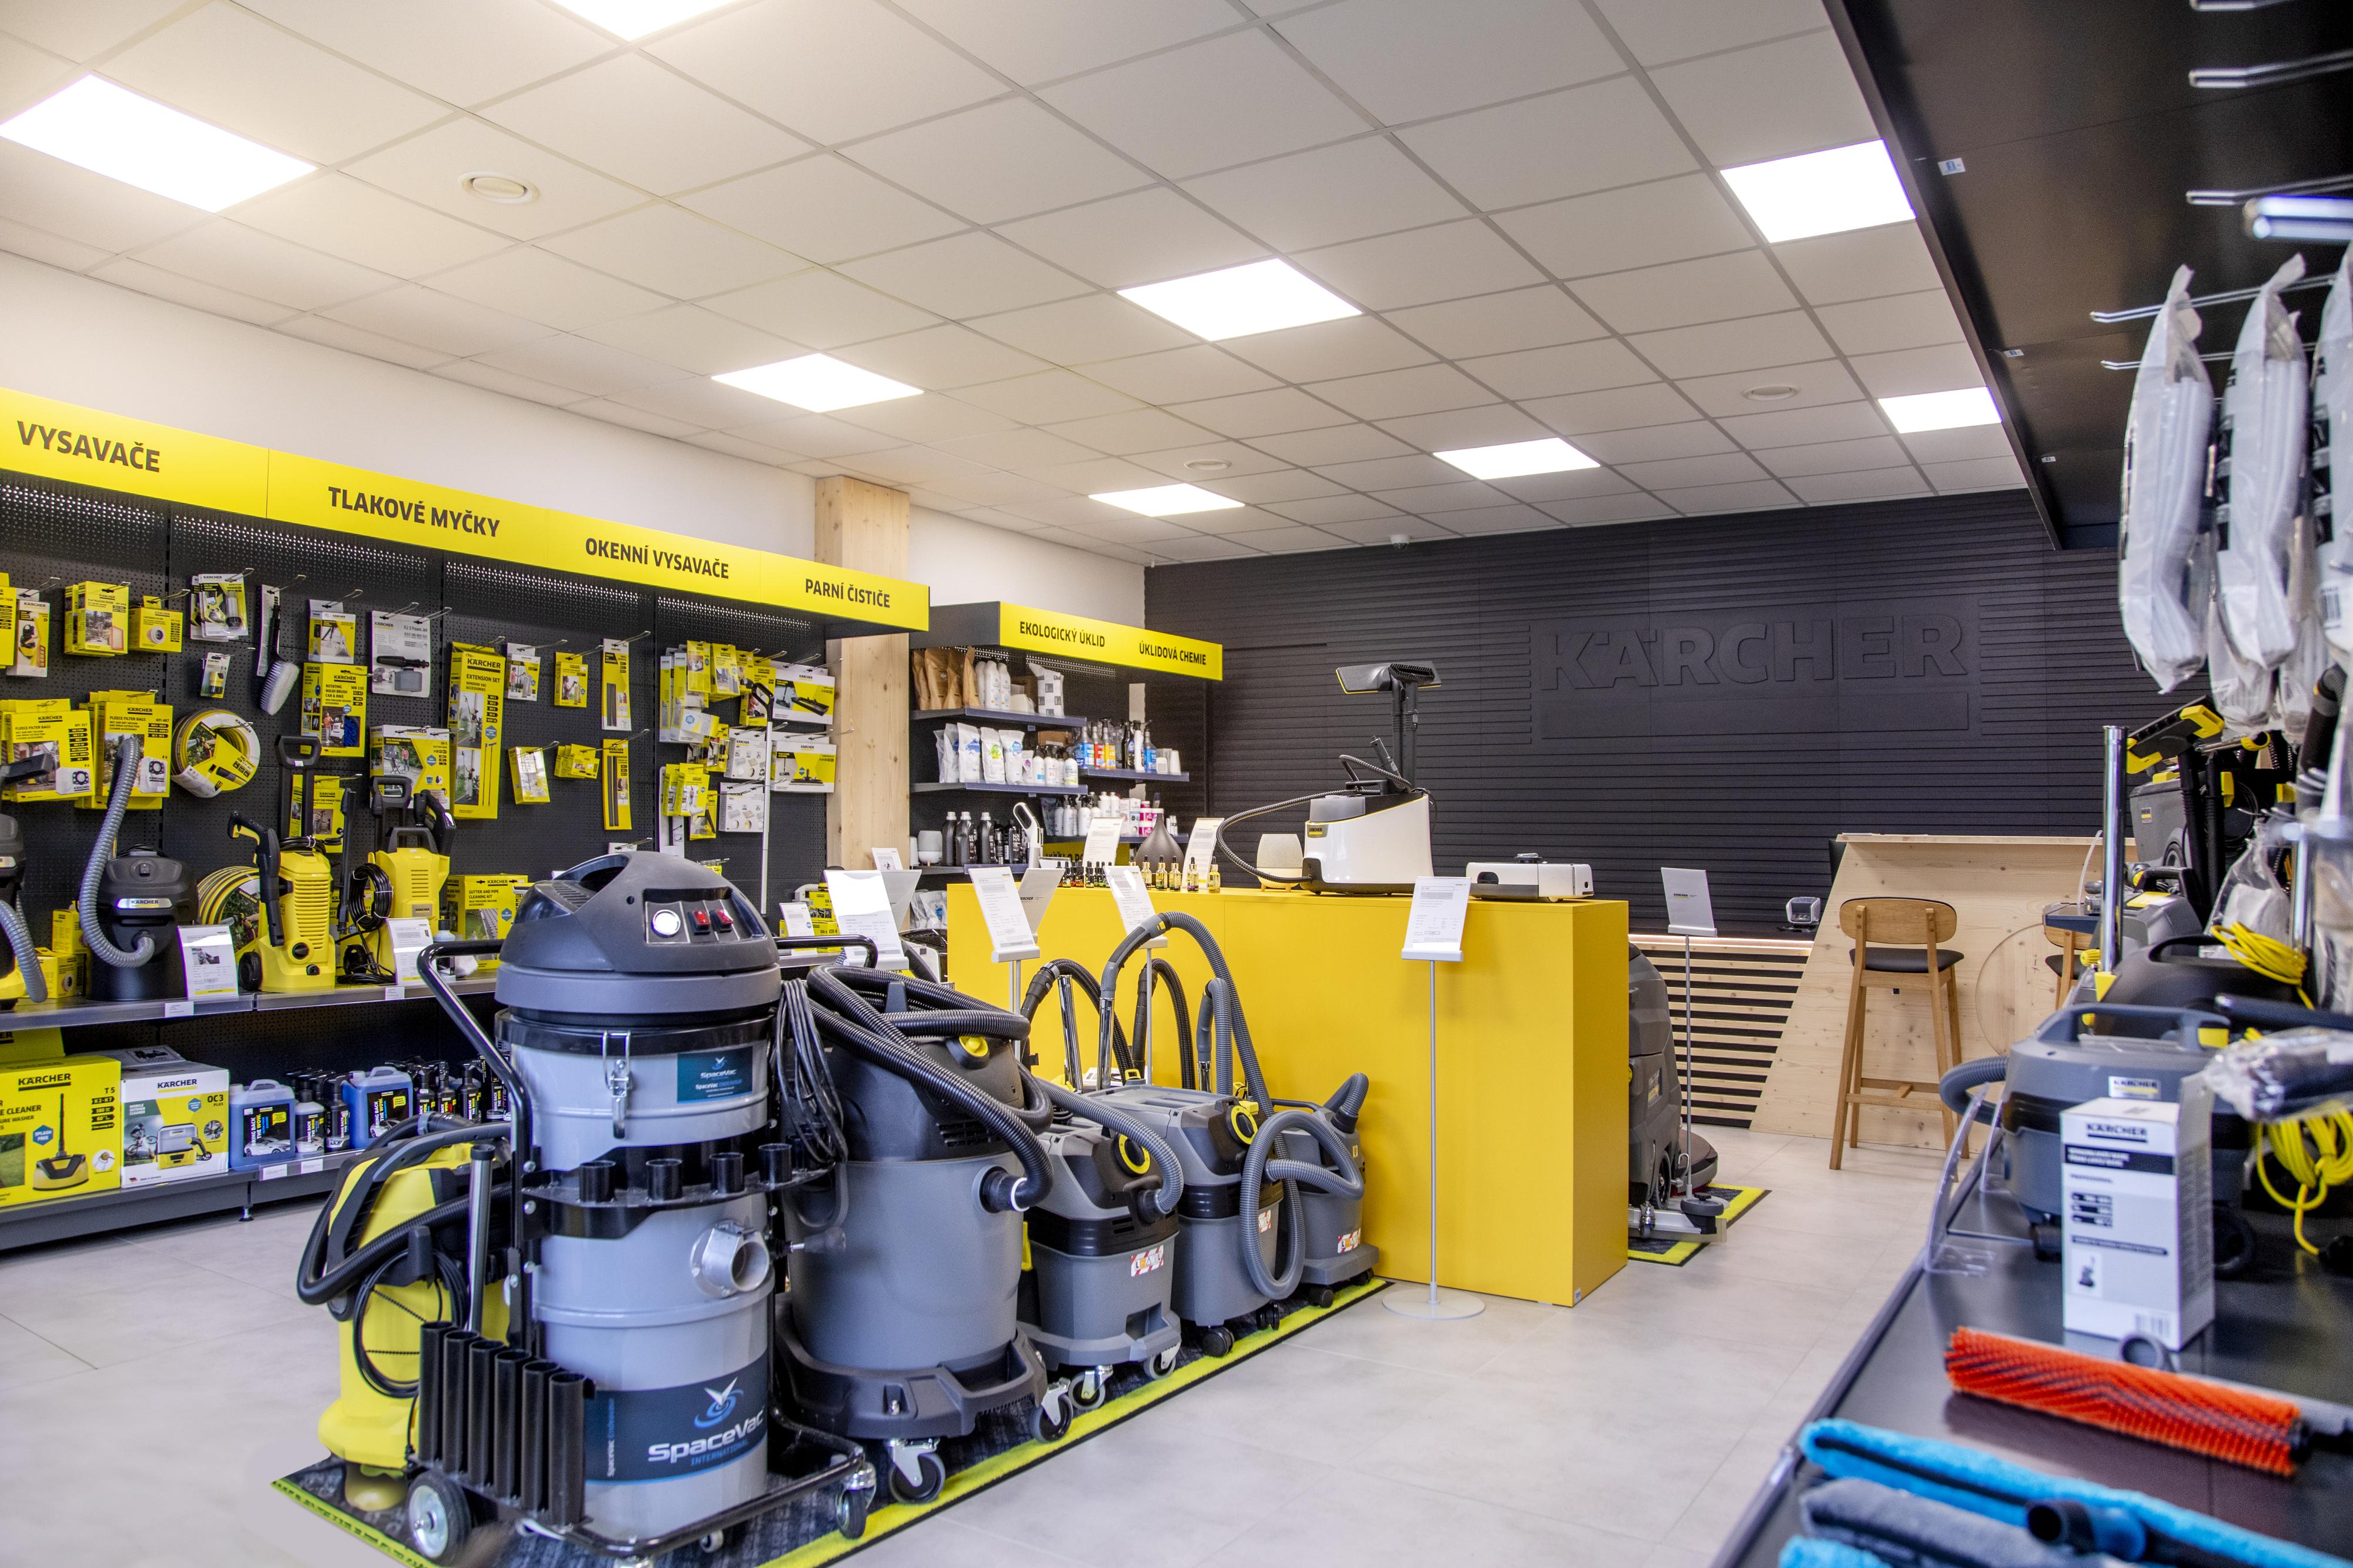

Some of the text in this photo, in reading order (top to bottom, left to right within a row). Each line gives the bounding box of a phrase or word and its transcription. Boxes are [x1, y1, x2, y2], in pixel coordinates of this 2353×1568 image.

[16, 421, 161, 473] VYSAVAČE
[328, 486, 501, 538] TLAKOVÉ MYČKY
[585, 538, 729, 580] OKENNÍ VYSAVAČE
[805, 578, 891, 608] PARNÍ ČISTIČE
[1019, 620, 1105, 648] EKOLOGICKÝ ÚKLID
[467, 658, 501, 669] KÄRCHER
[1139, 640, 1207, 666] ÚKLIDOVÁ CHEMIE
[1540, 613, 1968, 690] KÄRCHER
[466, 673, 491, 682] EXTENSION
[18, 1073, 71, 1086] KÄRCHER
[157, 1078, 198, 1089] KÄRCHER
[695, 1082, 718, 1090] SpaceVac
[700, 1069, 738, 1080] SpaceVac
[6, 1105, 42, 1115] CLEANER
[2086, 1123, 2147, 1136] KÄRCHER
[648, 1409, 764, 1464] SpaceVac
[691, 1439, 748, 1467] INTERNATIONAL
